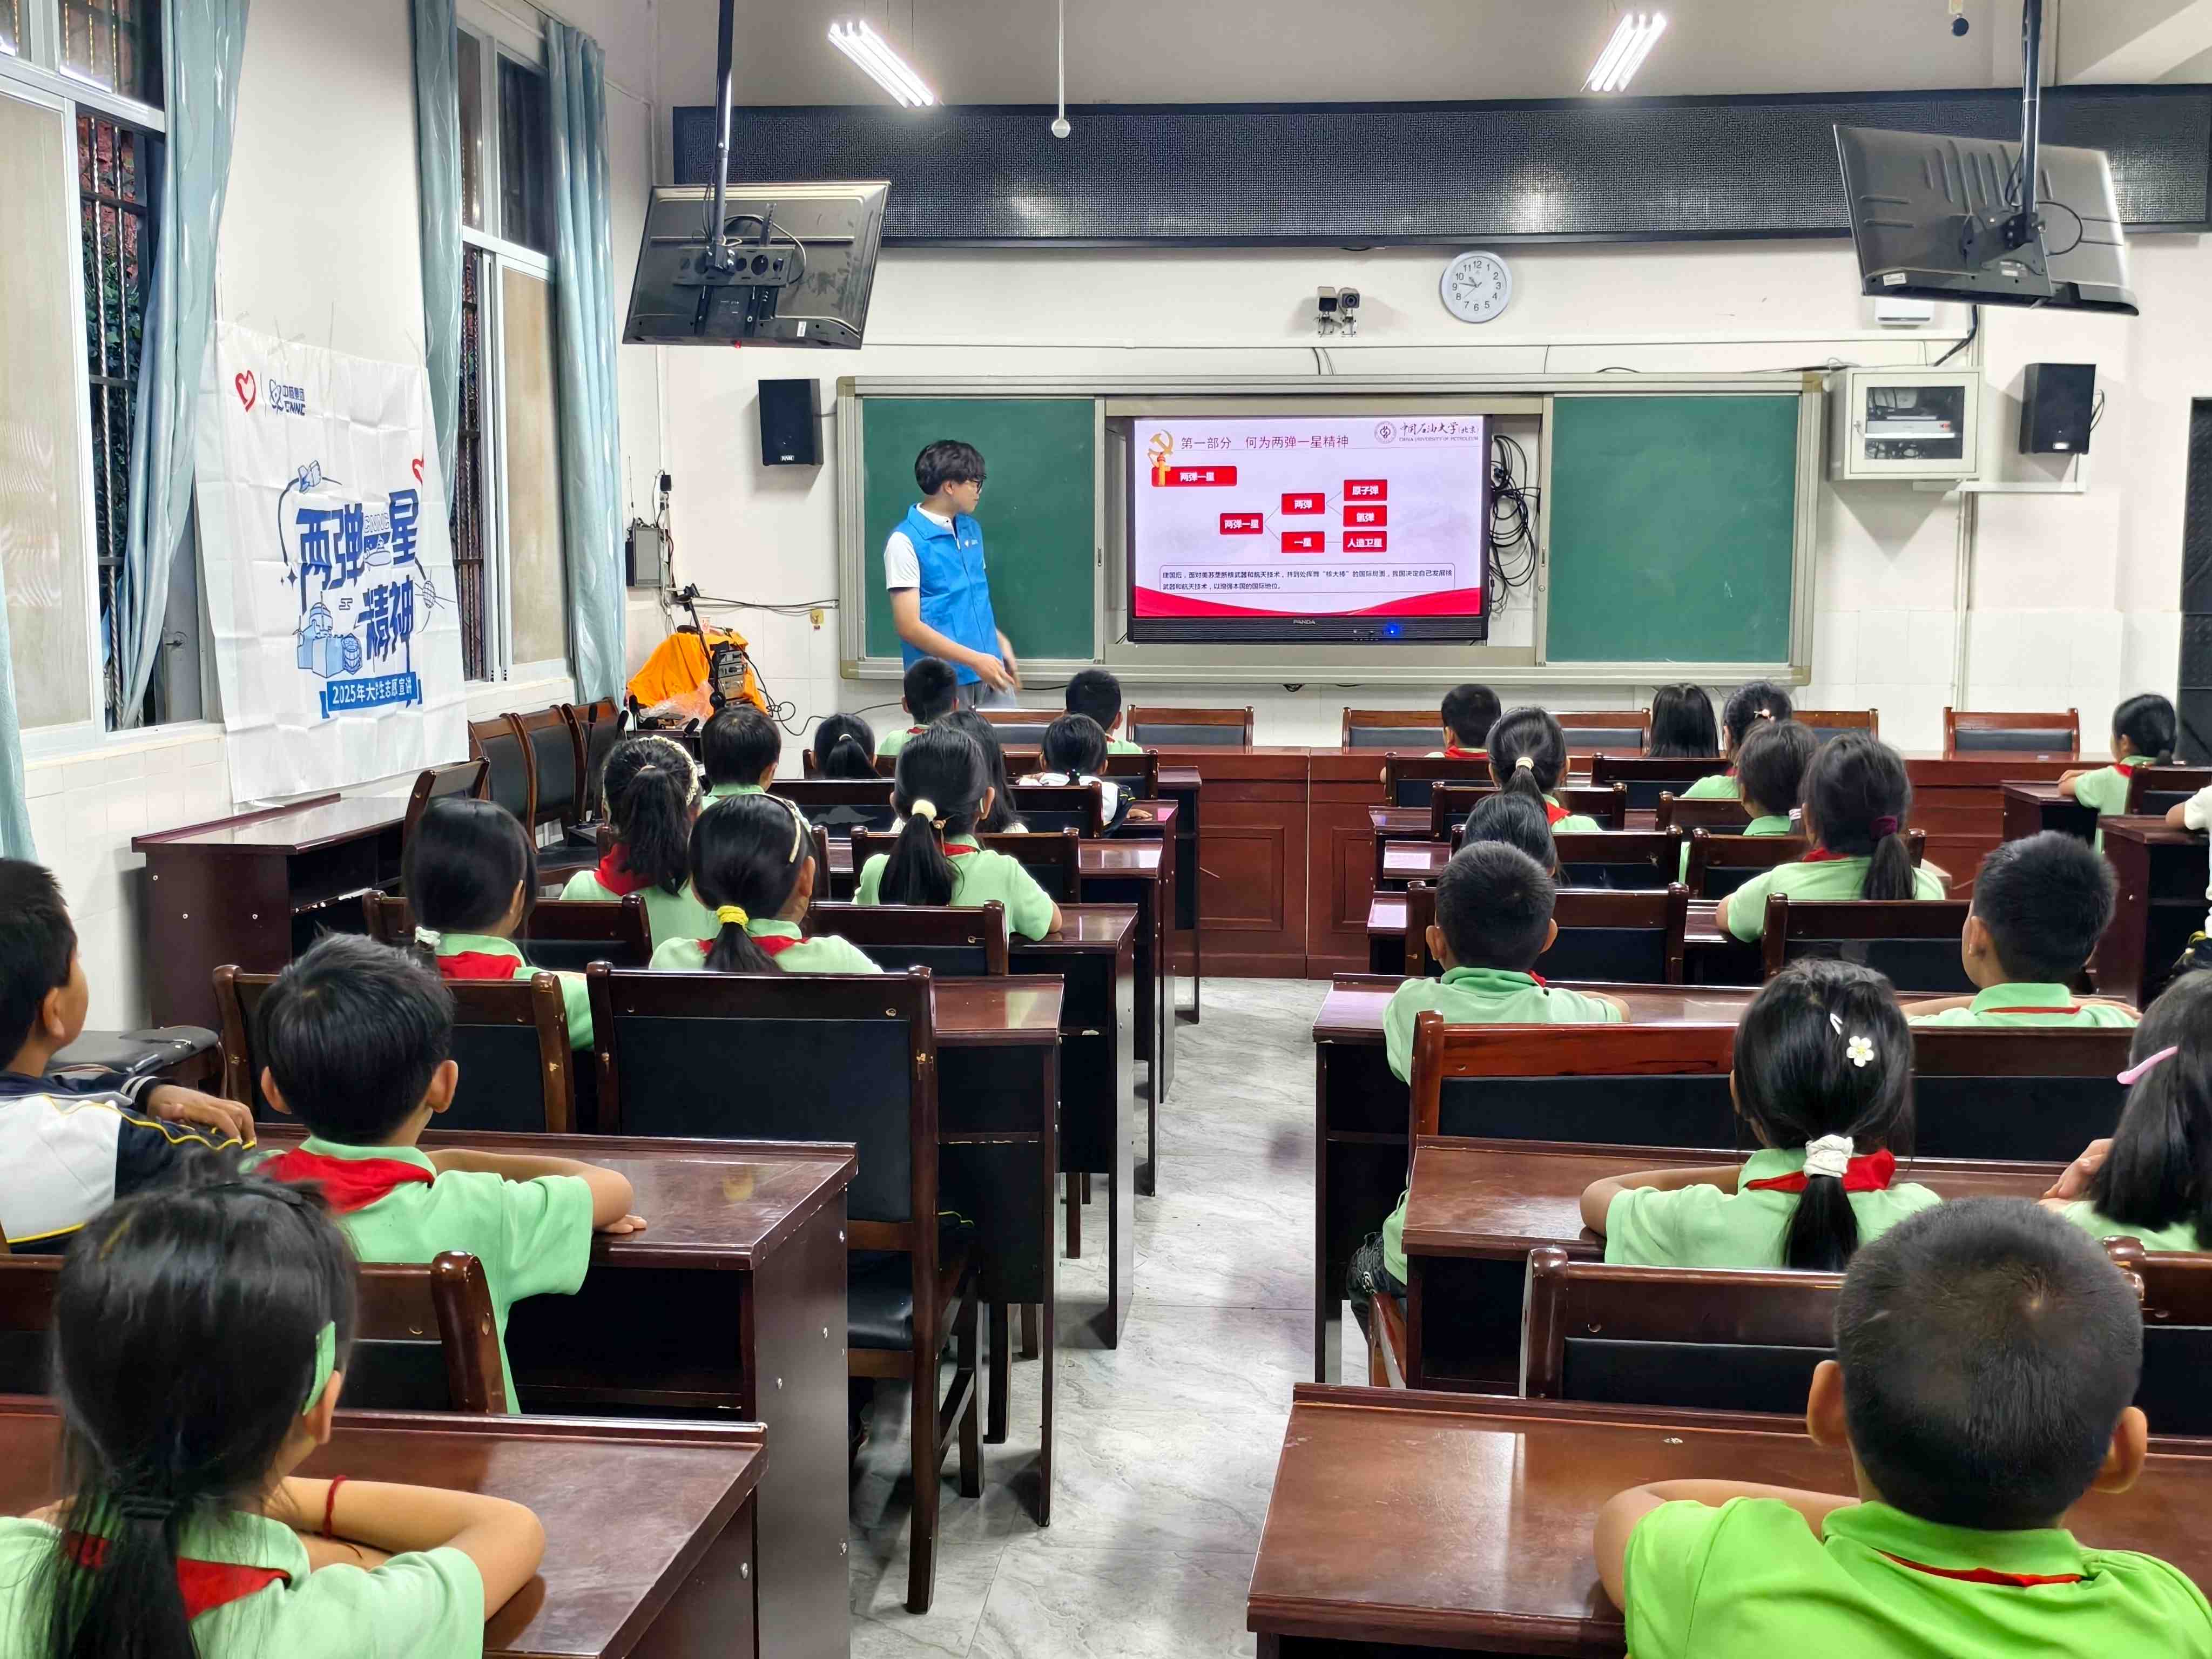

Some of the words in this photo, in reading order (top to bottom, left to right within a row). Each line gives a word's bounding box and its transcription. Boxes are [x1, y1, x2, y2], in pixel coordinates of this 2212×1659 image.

[1464, 264, 1471, 272] 11
[1473, 260, 1482, 268] 12
[284, 400, 306, 416] CNNC
[1181, 436, 1232, 450] 第一部分
[1245, 435, 1349, 449] 何为两弹一星精神
[1179, 471, 1215, 482] 两弹一星
[1352, 485, 1379, 496] 原子弹
[1294, 499, 1313, 509] 两弹
[363, 513, 390, 534] CNNC
[1224, 519, 1260, 530] 两弹一星
[1294, 538, 1312, 548] 一星
[296, 489, 419, 616] 两弹一星
[354, 574, 414, 675] 精神
